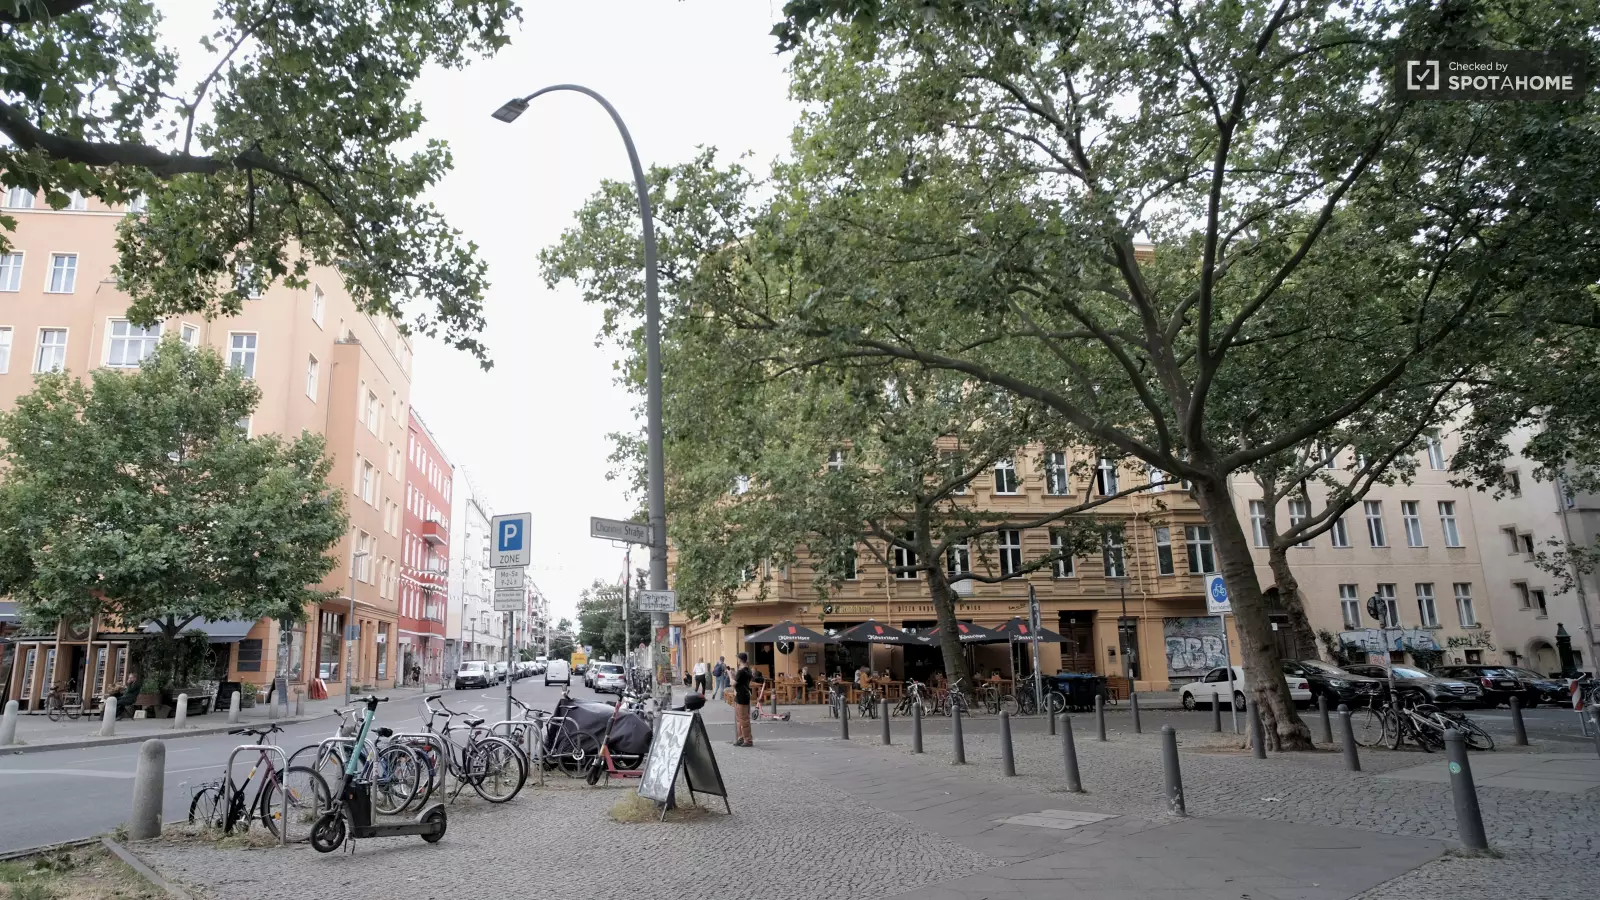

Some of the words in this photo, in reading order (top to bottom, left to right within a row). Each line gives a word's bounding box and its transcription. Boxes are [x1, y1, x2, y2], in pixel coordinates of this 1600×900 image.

[503, 523, 518, 548] P
[624, 524, 645, 539] Straße
[499, 554, 520, 564] ZONE
